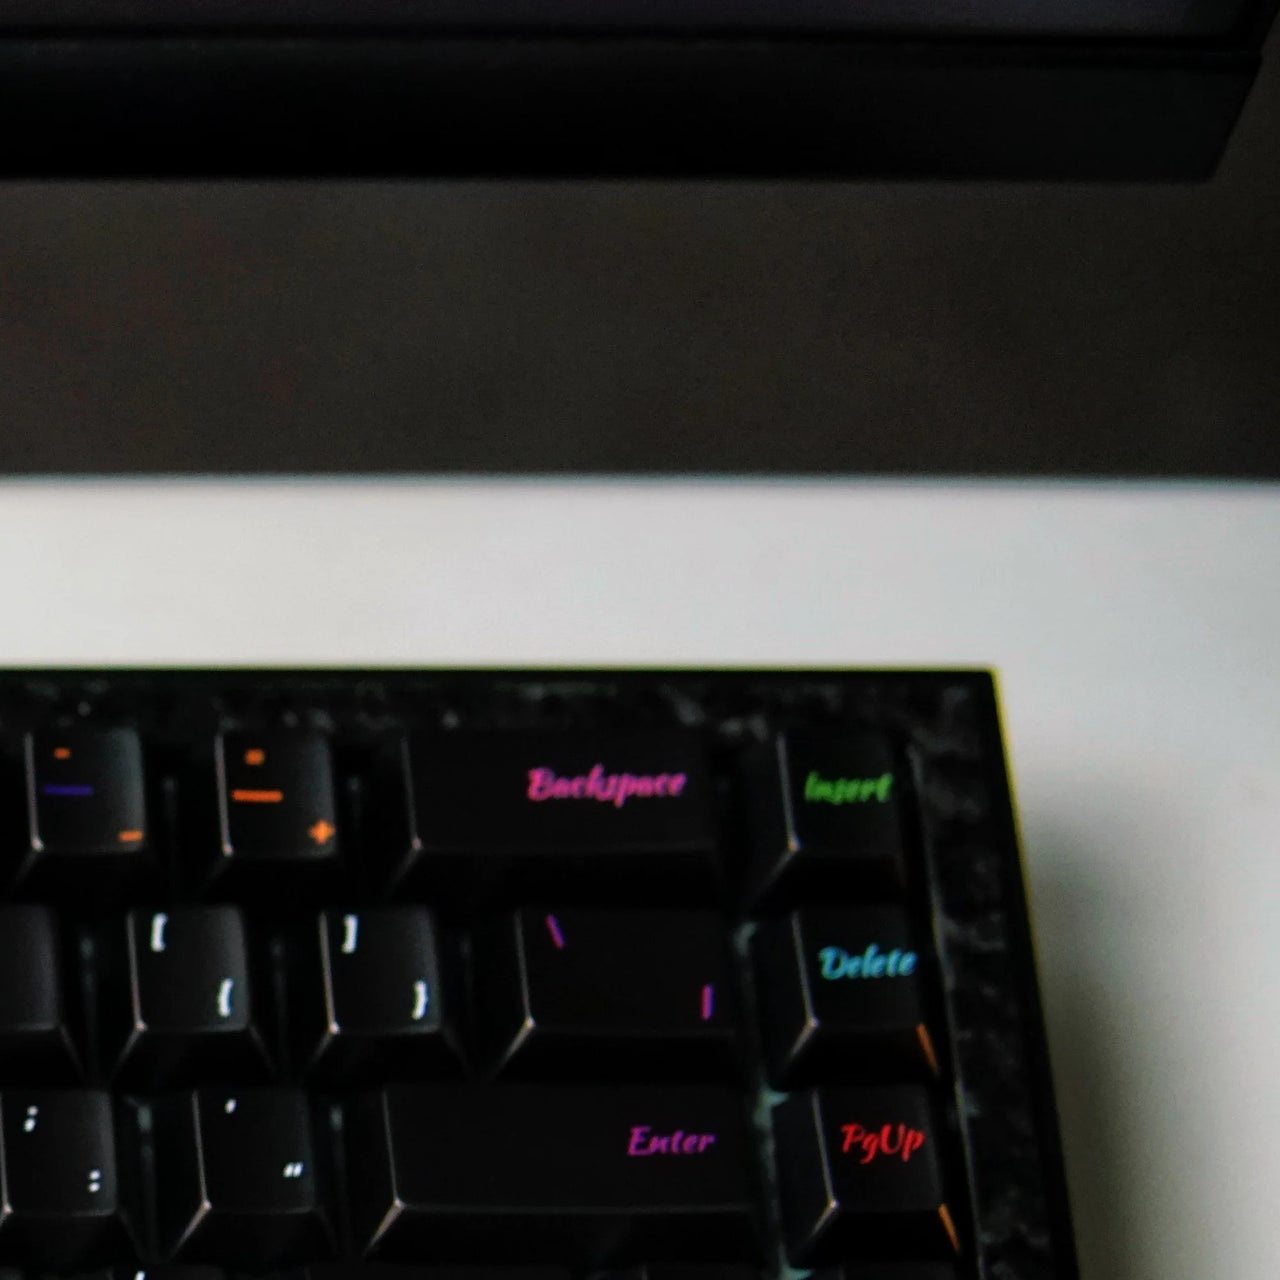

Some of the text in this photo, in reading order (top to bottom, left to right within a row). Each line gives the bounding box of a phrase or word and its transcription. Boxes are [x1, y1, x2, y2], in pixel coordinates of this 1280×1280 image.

[527, 766, 686, 806] Backspace
[805, 773, 892, 804] Insert
[820, 944, 918, 980] Delete
[627, 1125, 717, 1156] Enter
[842, 1123, 925, 1164] PgUp
